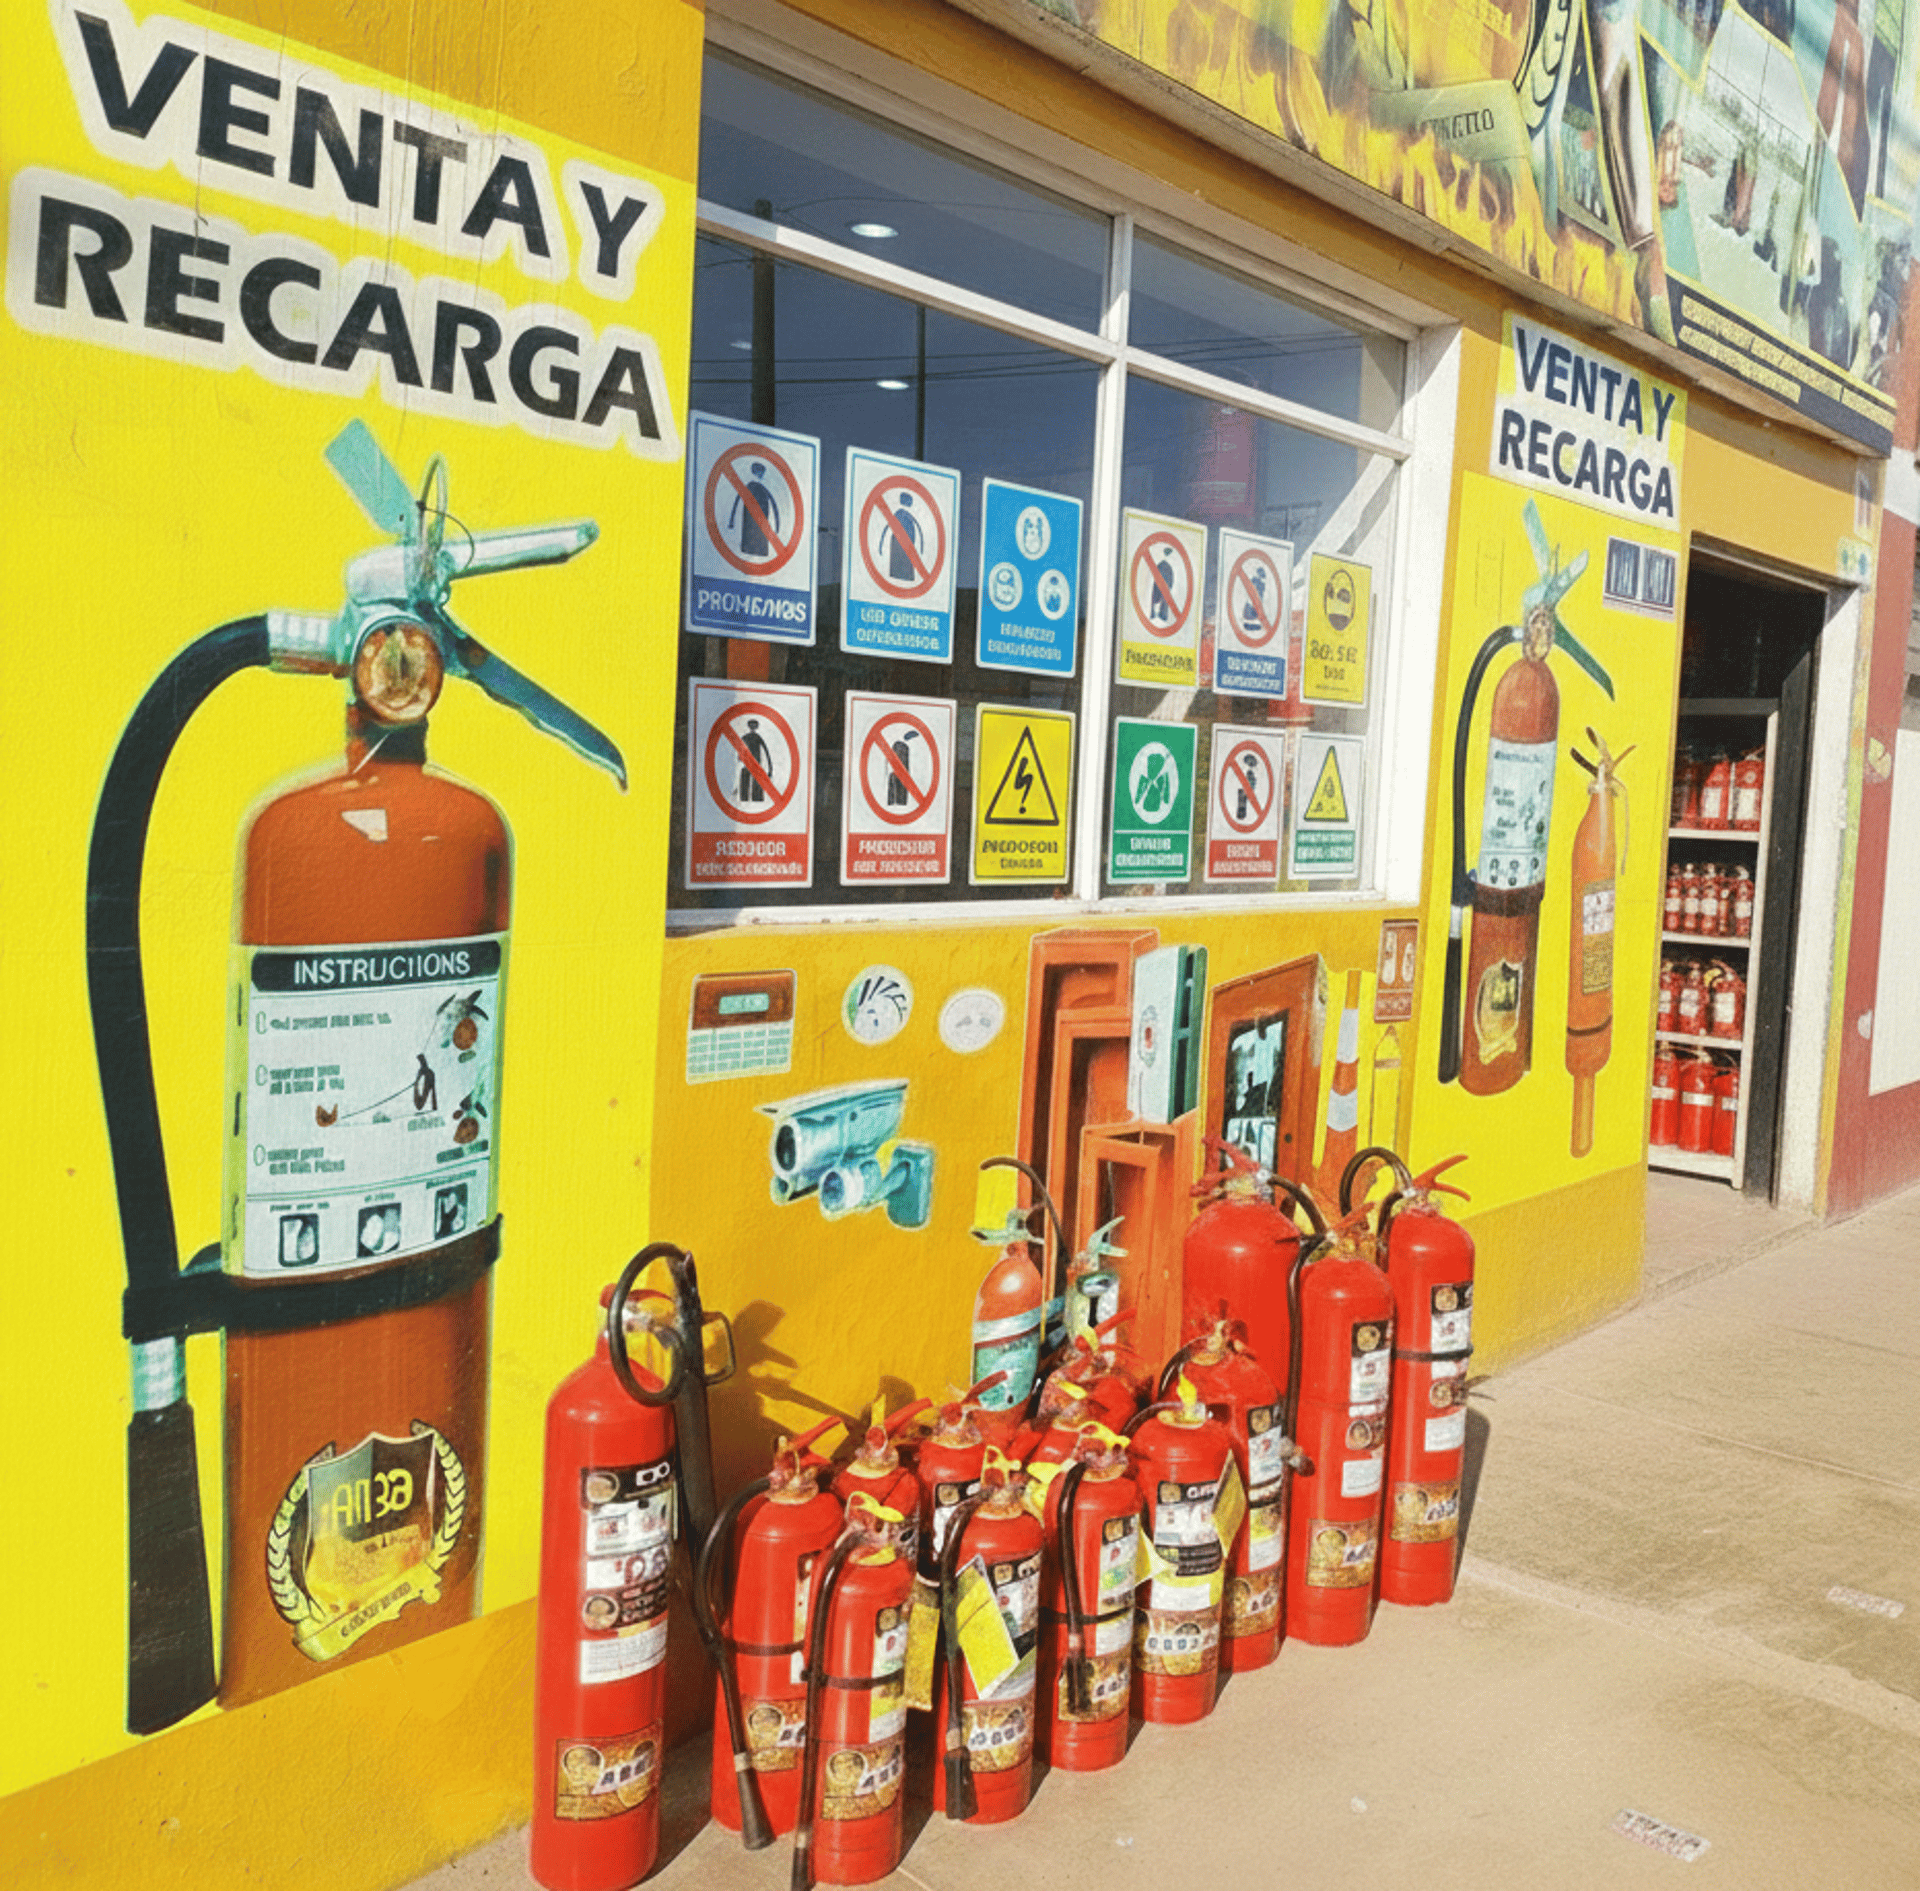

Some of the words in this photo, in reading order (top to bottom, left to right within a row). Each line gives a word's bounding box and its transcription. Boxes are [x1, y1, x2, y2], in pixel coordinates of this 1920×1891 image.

[74, 9, 551, 259] VENTA
[579, 180, 648, 279] Y
[34, 195, 662, 441] RECARGA
[1515, 326, 1644, 435] VENTA
[1652, 386, 1676, 442] Y
[1499, 408, 1674, 518] RECARGA
